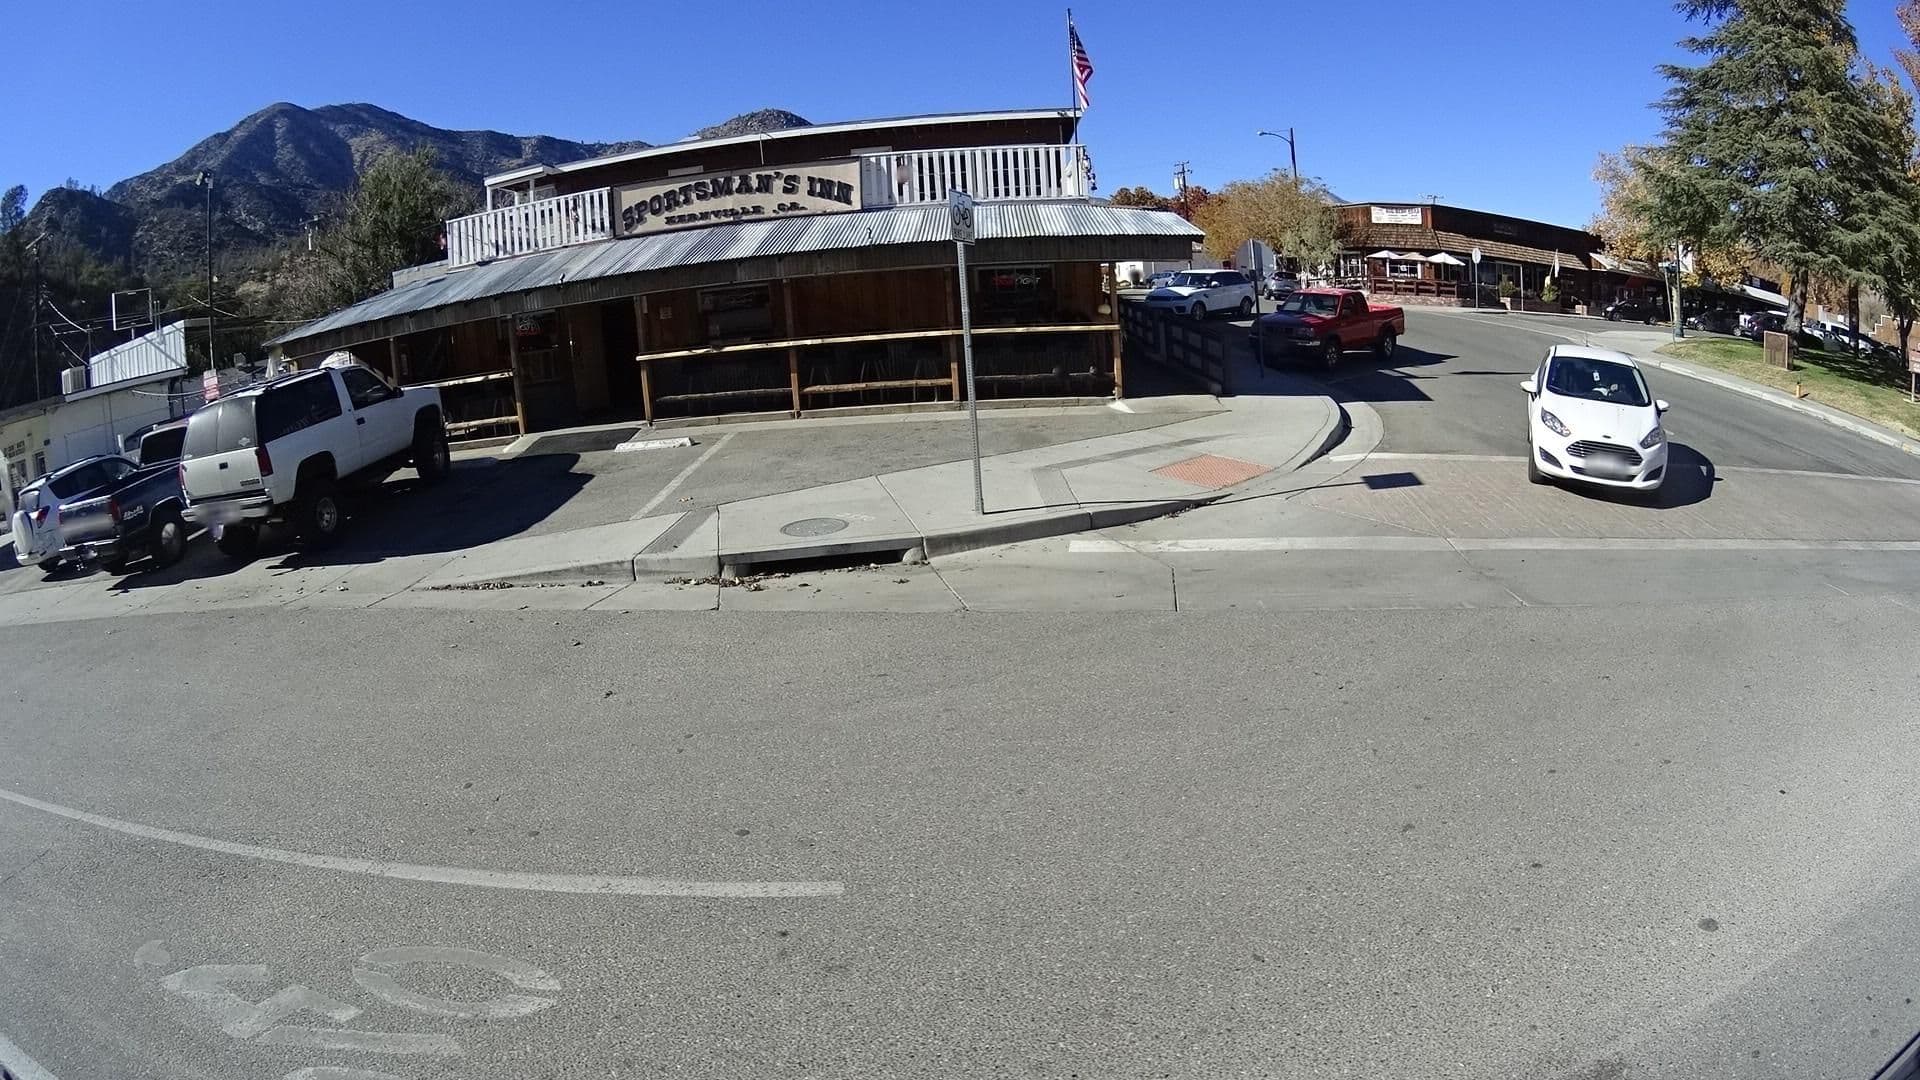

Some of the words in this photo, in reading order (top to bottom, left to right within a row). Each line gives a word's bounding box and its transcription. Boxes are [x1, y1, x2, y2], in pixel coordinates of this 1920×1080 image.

[622, 171, 801, 233] SPORTSMAN'S
[807, 176, 854, 205] INN
[664, 205, 765, 225] KERNVILLE
